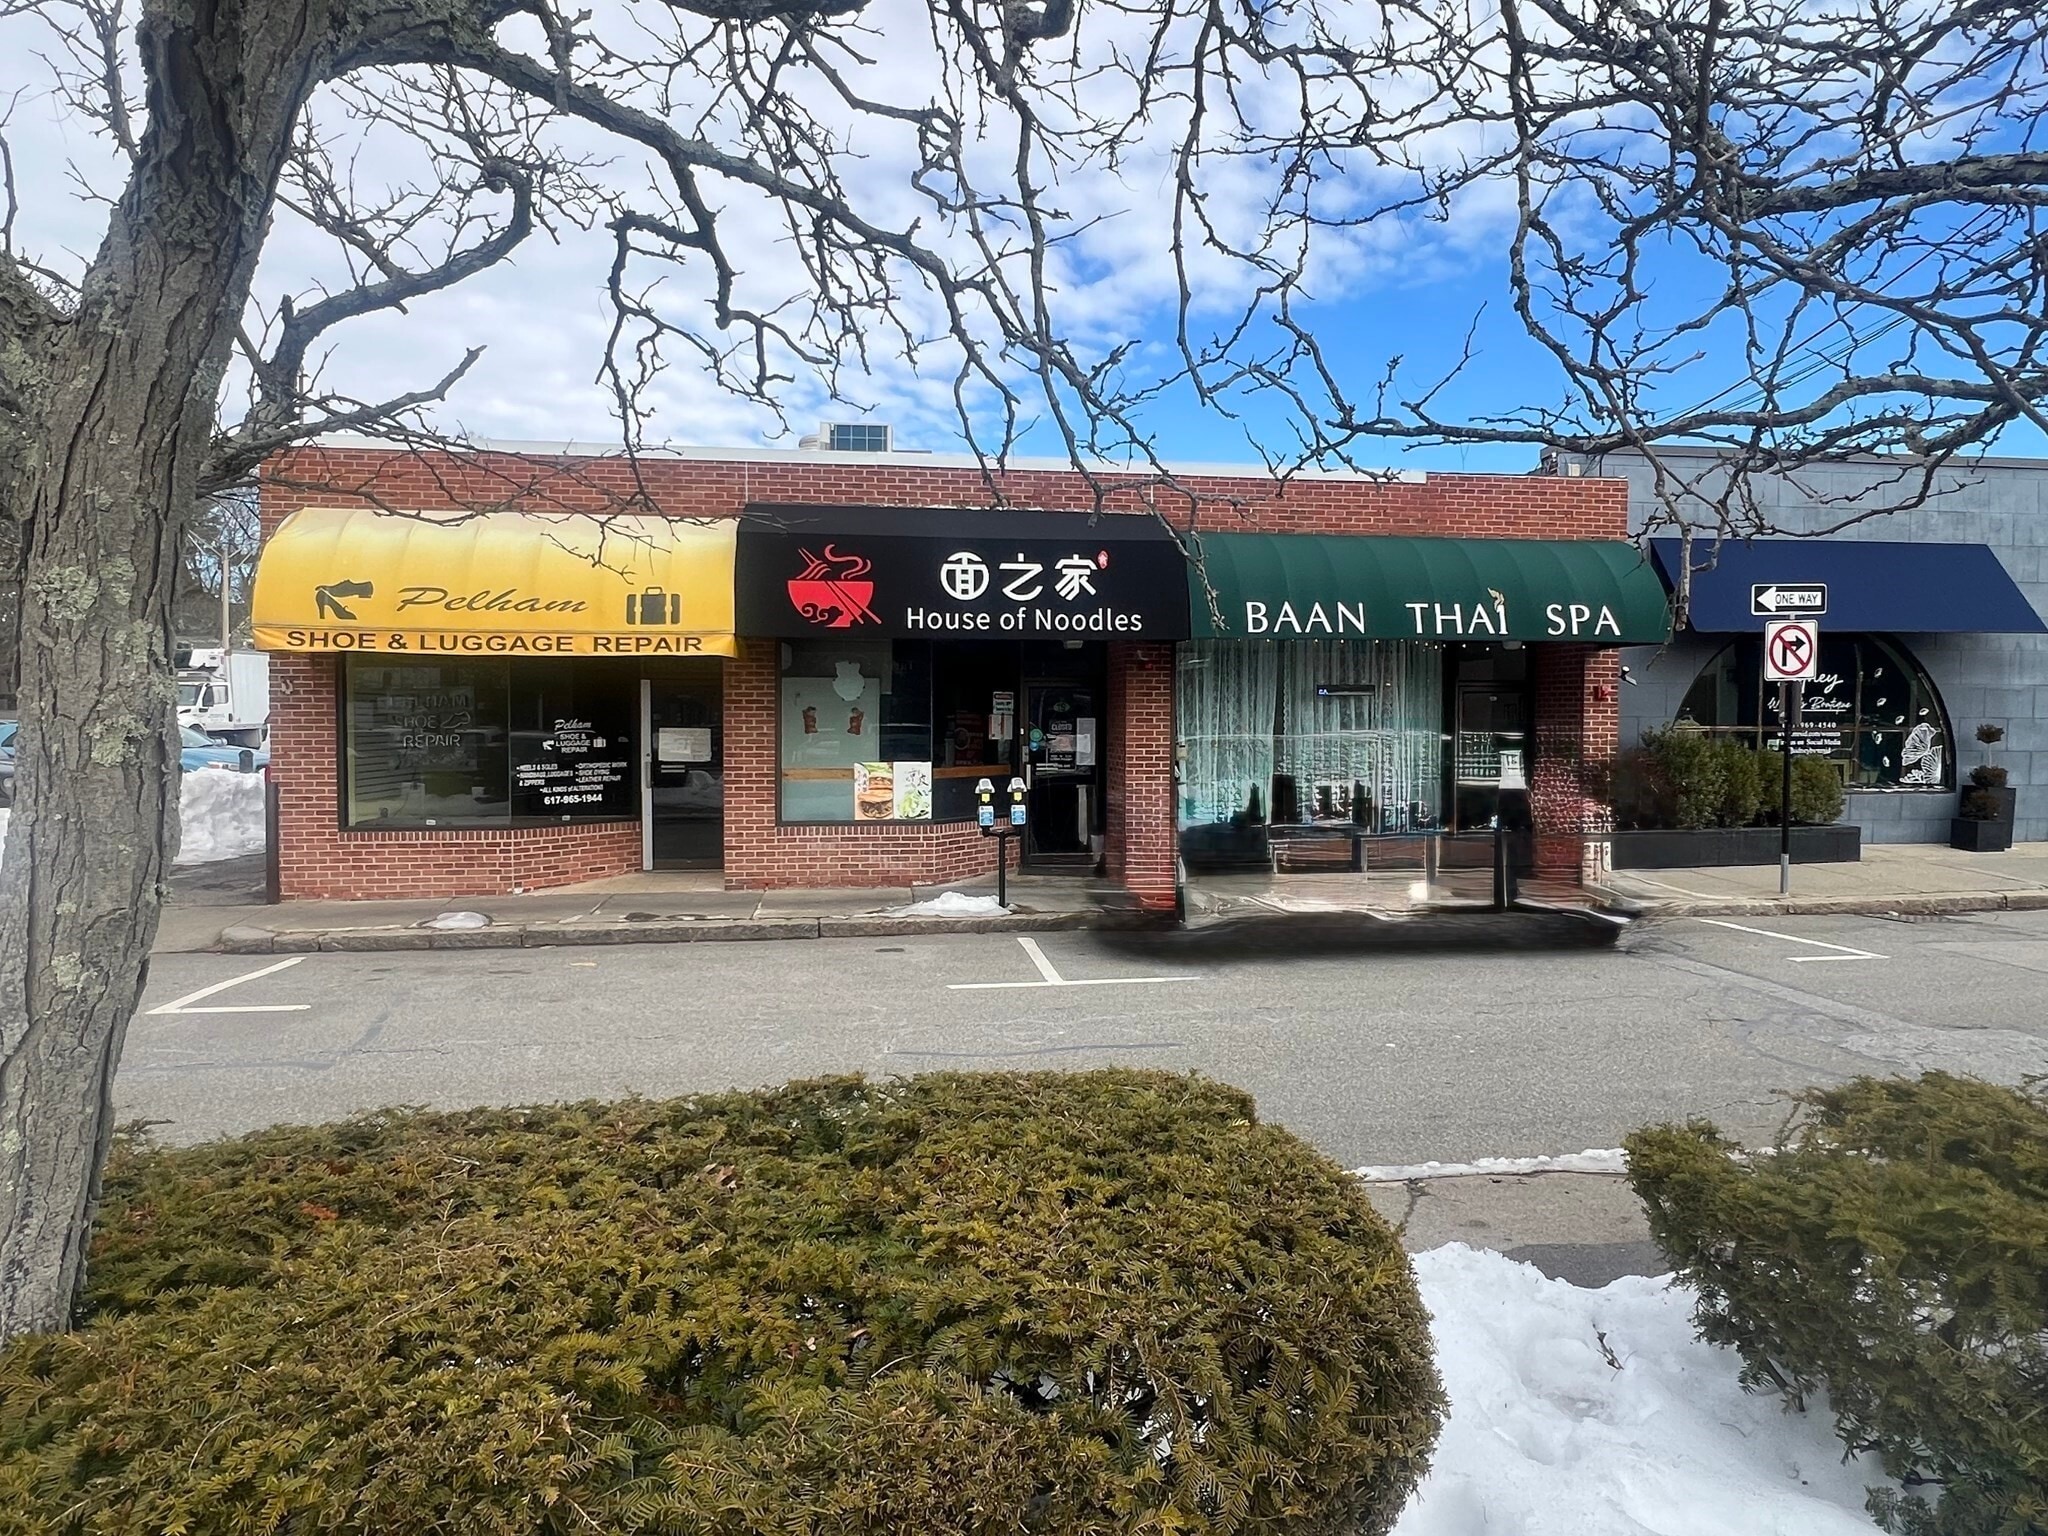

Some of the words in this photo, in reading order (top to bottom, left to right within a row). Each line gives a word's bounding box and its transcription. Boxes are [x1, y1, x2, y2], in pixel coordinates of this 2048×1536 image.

[940, 551, 1098, 601] 面之家
[398, 586, 588, 614] Pelham
[1775, 594, 1795, 604] ONE
[1798, 594, 1818, 604] WAY
[907, 608, 989, 630] House
[999, 608, 1026, 630] of
[1035, 608, 1142, 632] Noodles
[1246, 602, 1365, 634] BAAN
[1546, 604, 1621, 636] SPA
[286, 630, 376, 650] SHOE
[388, 633, 408, 650] &
[420, 634, 574, 653] LUGGAGE
[592, 636, 702, 653] REPAIR
[403, 734, 460, 748] REPAIR
[544, 793, 602, 805] 617-965-1944
